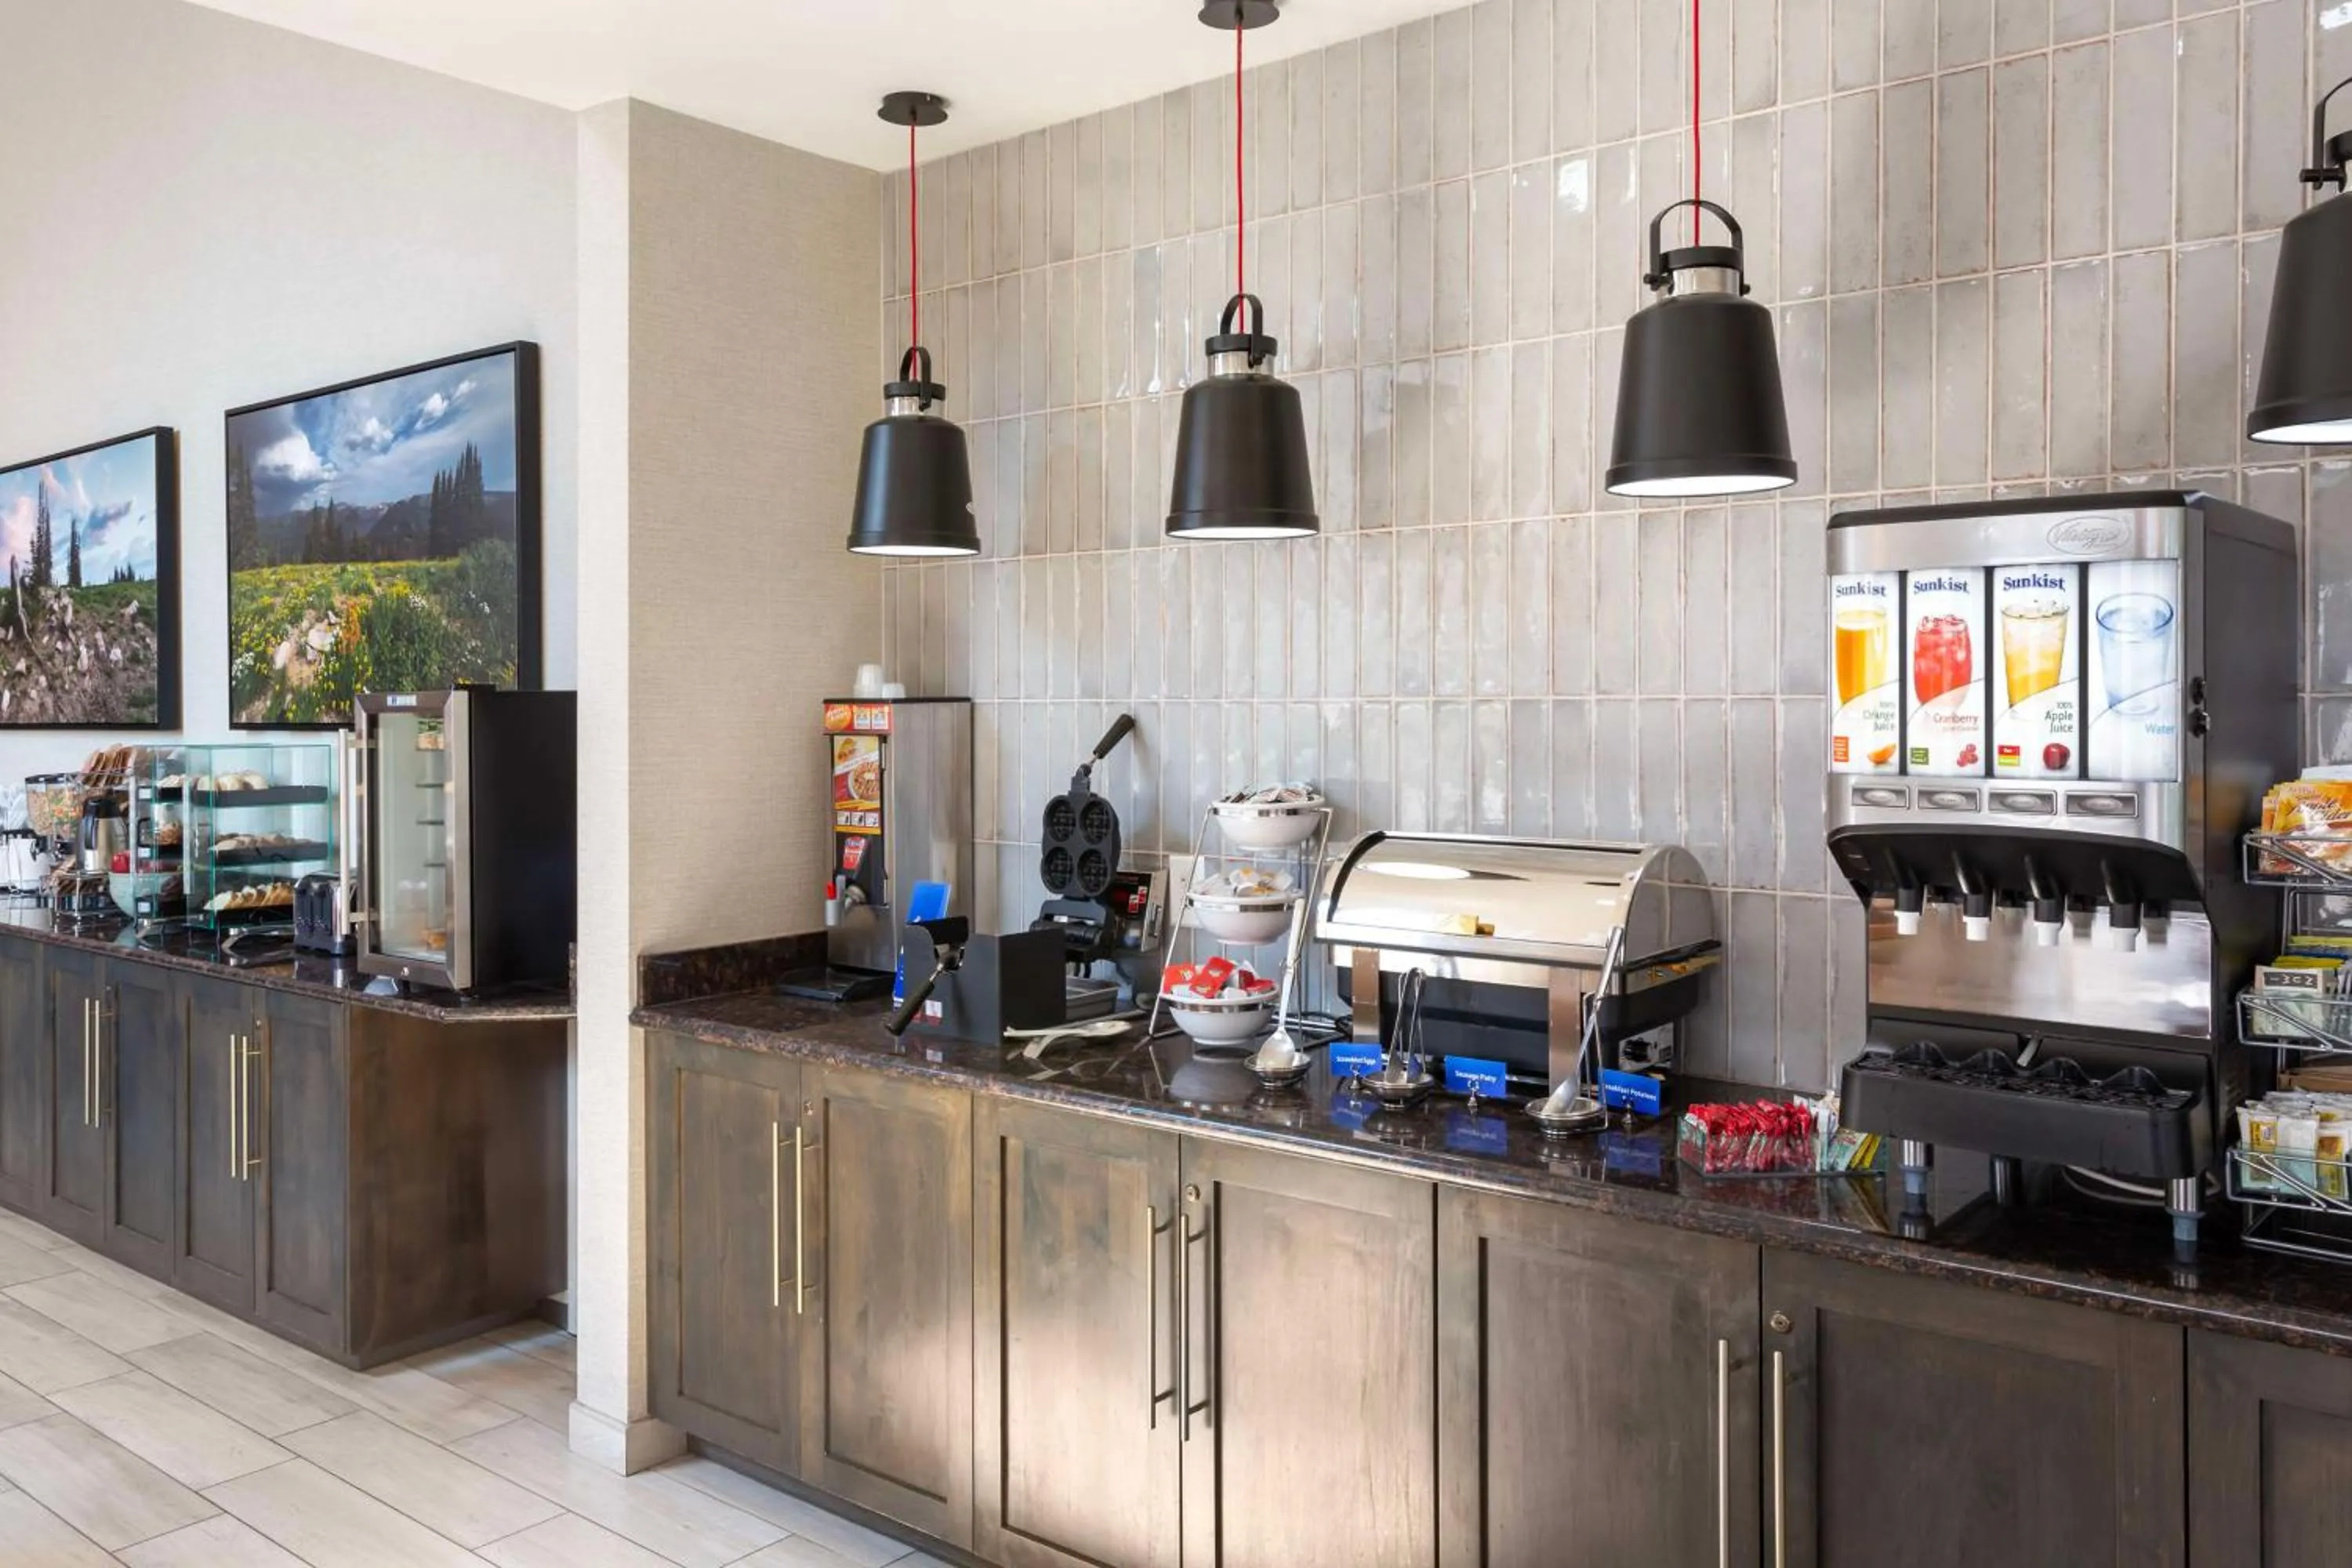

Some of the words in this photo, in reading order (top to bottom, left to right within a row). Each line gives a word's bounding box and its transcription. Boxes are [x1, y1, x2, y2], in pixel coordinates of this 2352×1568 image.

[1836, 581, 1887, 597] Sunkist
[1913, 577, 1970, 594] Sunkist
[2003, 573, 2066, 593] Sunkist
[1933, 712, 1979, 726] Cranberry
[2044, 710, 2074, 723] Apple
[2049, 722, 2074, 734] Juice
[2145, 723, 2176, 735] Water
